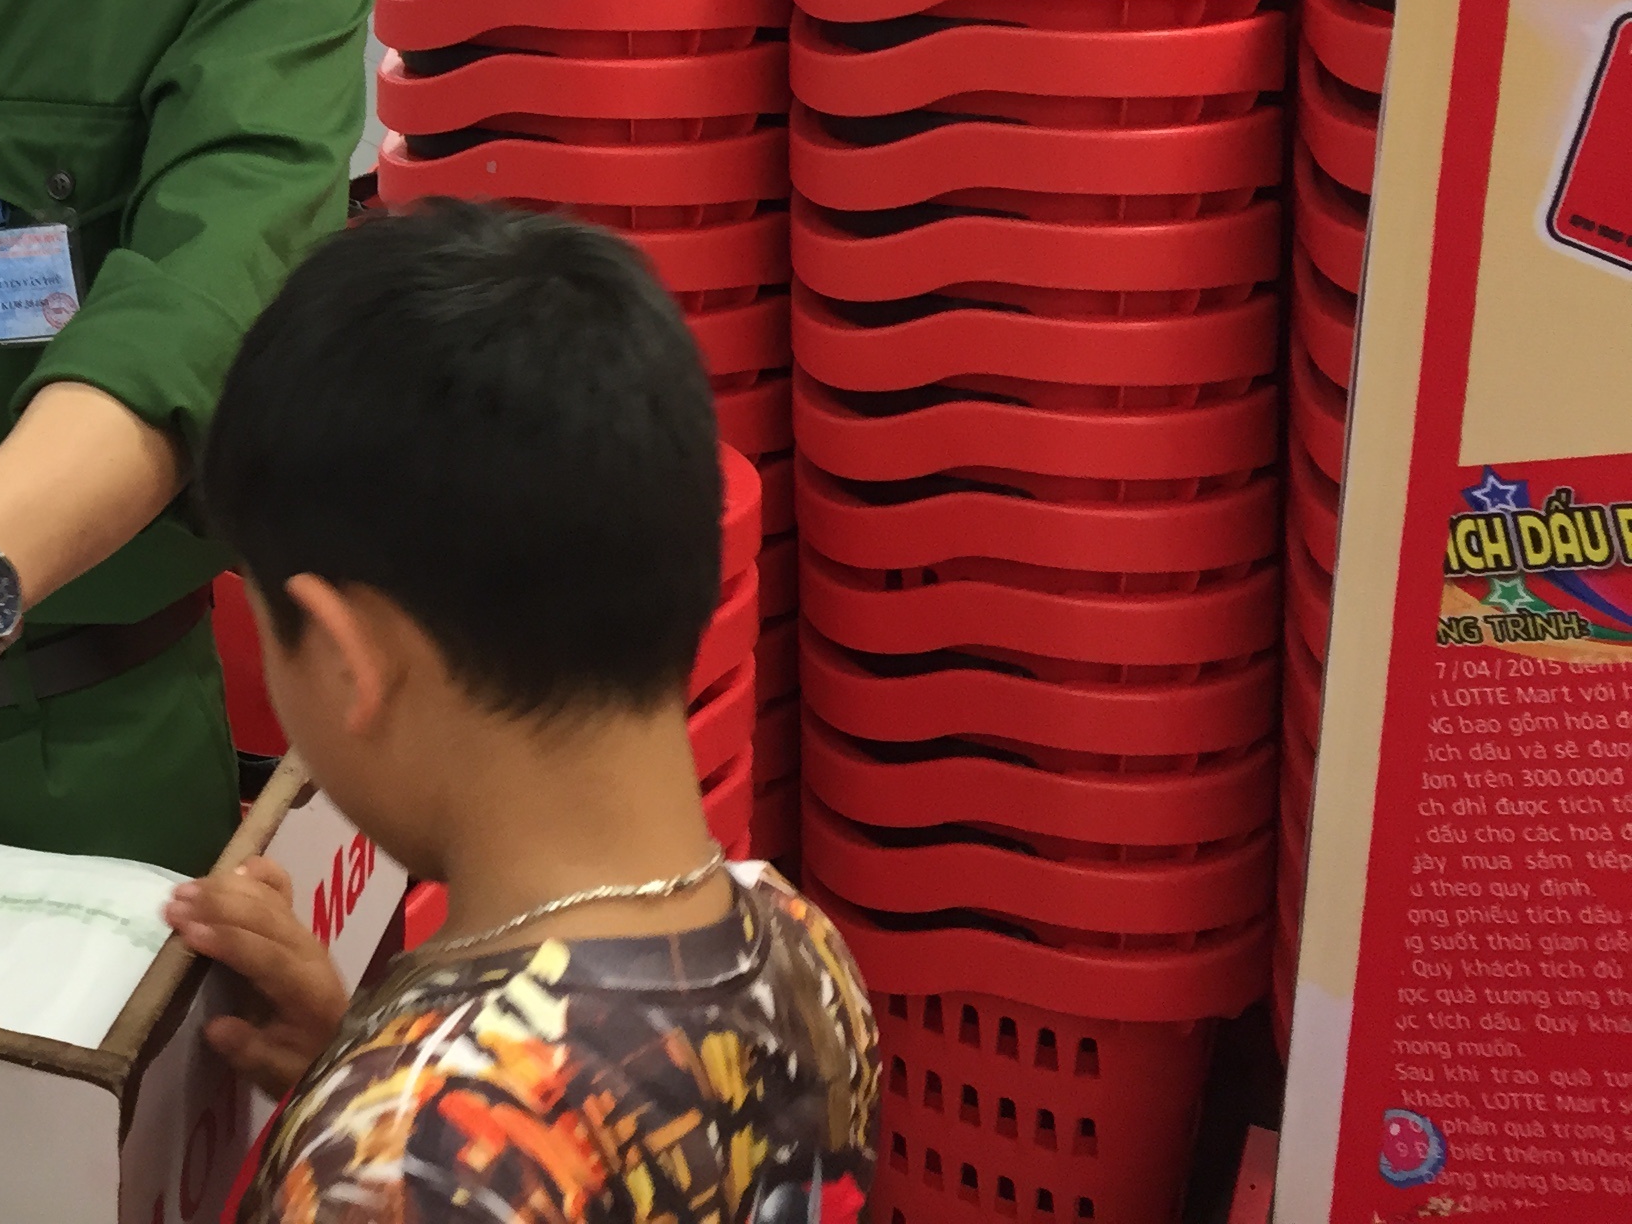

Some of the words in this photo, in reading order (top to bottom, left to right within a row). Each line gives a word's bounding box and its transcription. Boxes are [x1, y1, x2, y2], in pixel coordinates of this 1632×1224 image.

[1435, 658, 1562, 681] 7/04/2015
[1442, 687, 1510, 707] LOTTE
[1516, 686, 1574, 704] Mart
[1578, 682, 1616, 702] với
[1458, 715, 1502, 733] bao
[1518, 741, 1547, 759] và
[1463, 769, 1514, 789] trên
[1418, 797, 1445, 816] ch
[1474, 824, 1516, 843] cho
[1522, 823, 1563, 842] các
[1462, 854, 1512, 870] mua
[1430, 879, 1482, 897] theo
[1489, 881, 1531, 901] quy
[1538, 934, 1589, 954] gian
[1461, 958, 1532, 977] khách
[1394, 1063, 1434, 1082] Sau
[1442, 1063, 1480, 1083] khi
[1490, 1066, 1539, 1085] trao
[1481, 1092, 1548, 1111] LOTTE
[1555, 1093, 1611, 1113] Mart
